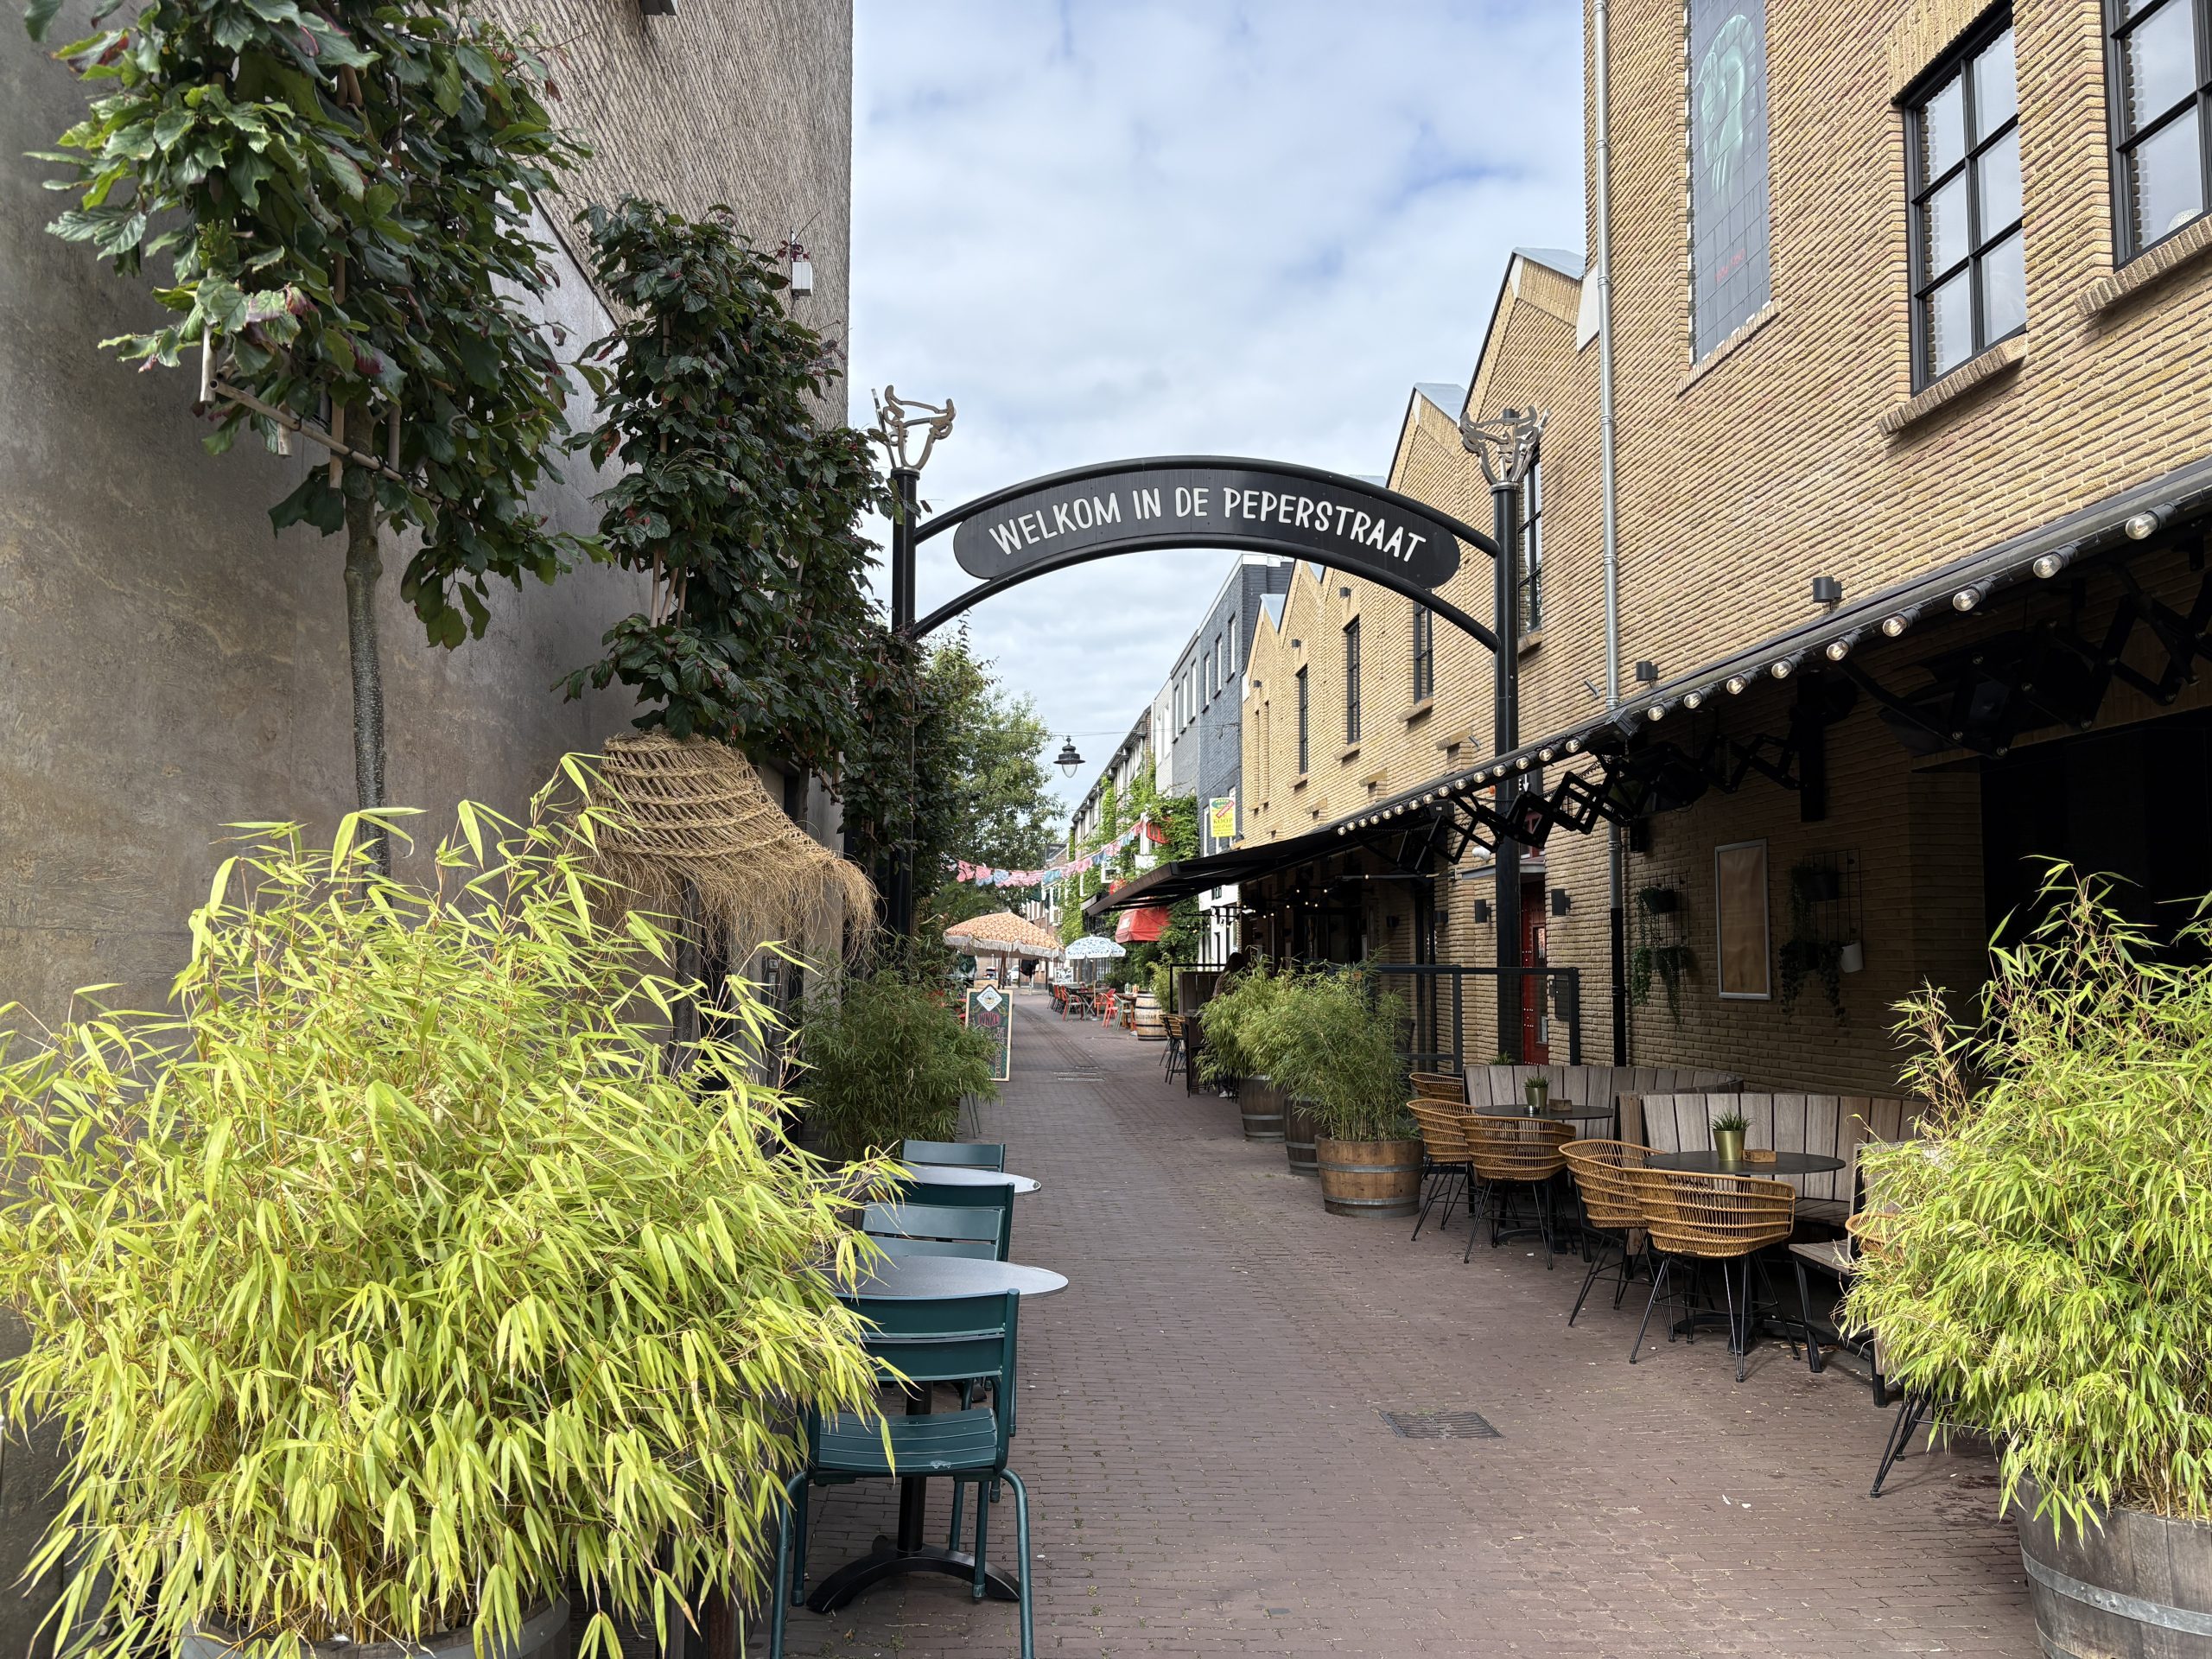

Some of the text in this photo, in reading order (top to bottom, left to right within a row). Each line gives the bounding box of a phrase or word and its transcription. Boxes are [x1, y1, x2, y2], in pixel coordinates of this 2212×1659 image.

[988, 486, 1427, 563] WELKOM IN DE PEPERSTRAAT
